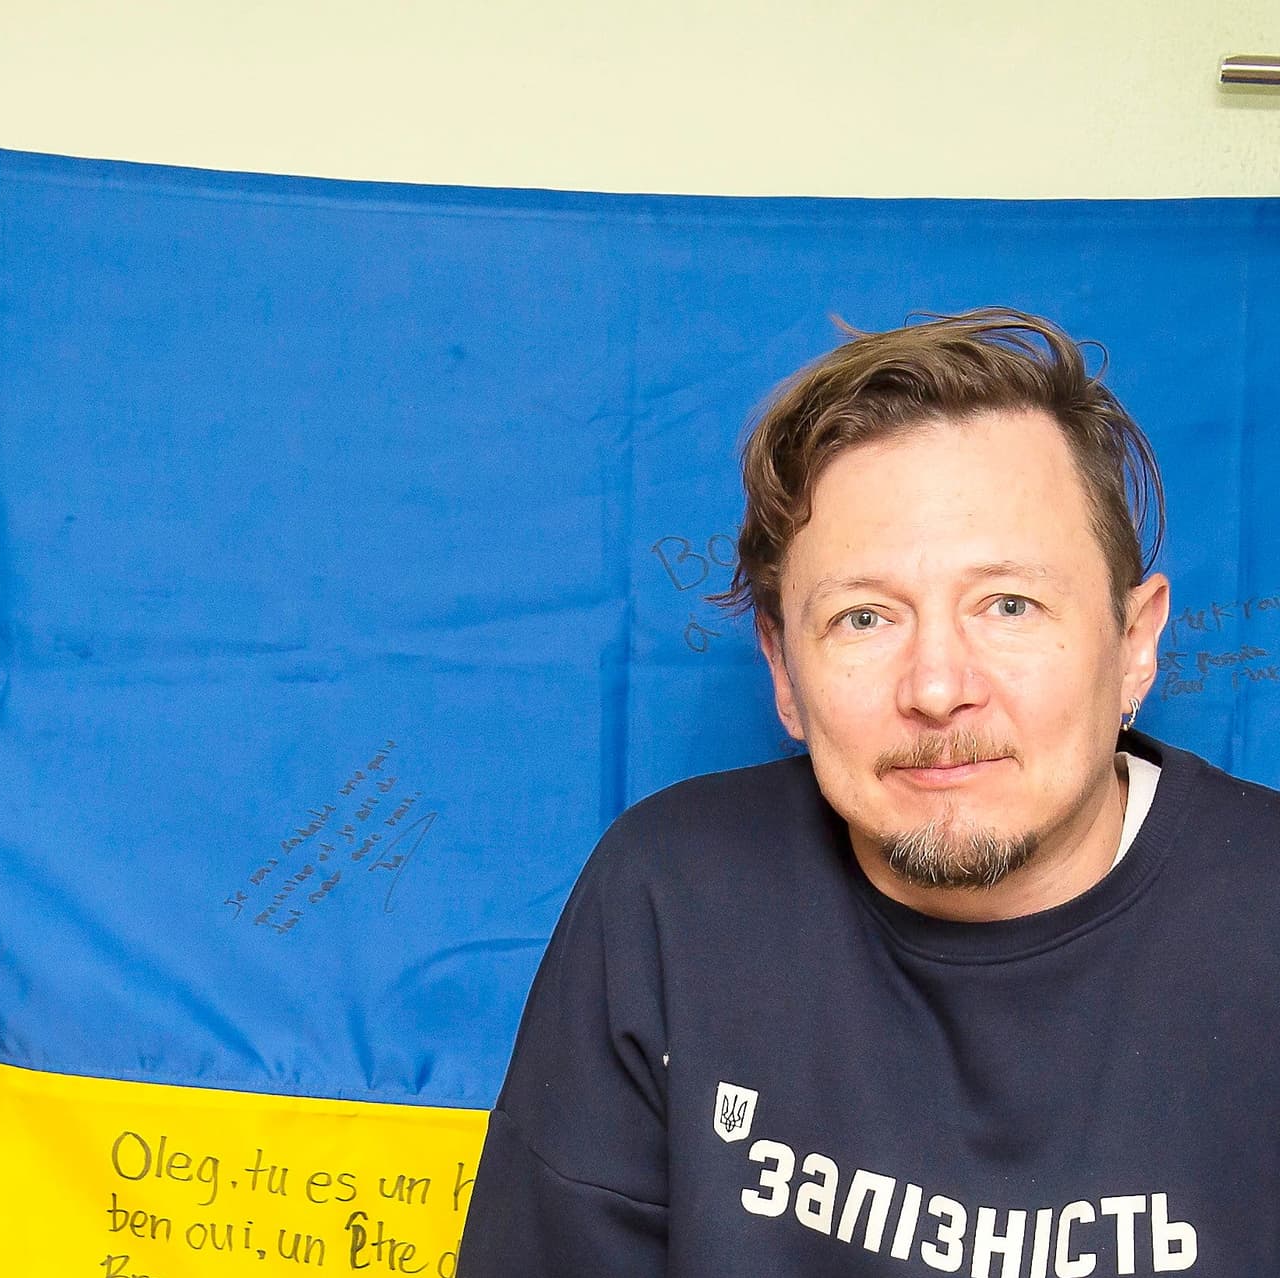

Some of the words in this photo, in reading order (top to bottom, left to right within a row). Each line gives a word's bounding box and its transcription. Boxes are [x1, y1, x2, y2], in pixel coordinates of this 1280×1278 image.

[244, 1148, 289, 1197] tu
[306, 1171, 357, 1204] es
[379, 1174, 431, 1205] un
[106, 1192, 171, 1243] ben
[277, 1228, 325, 1267] un
